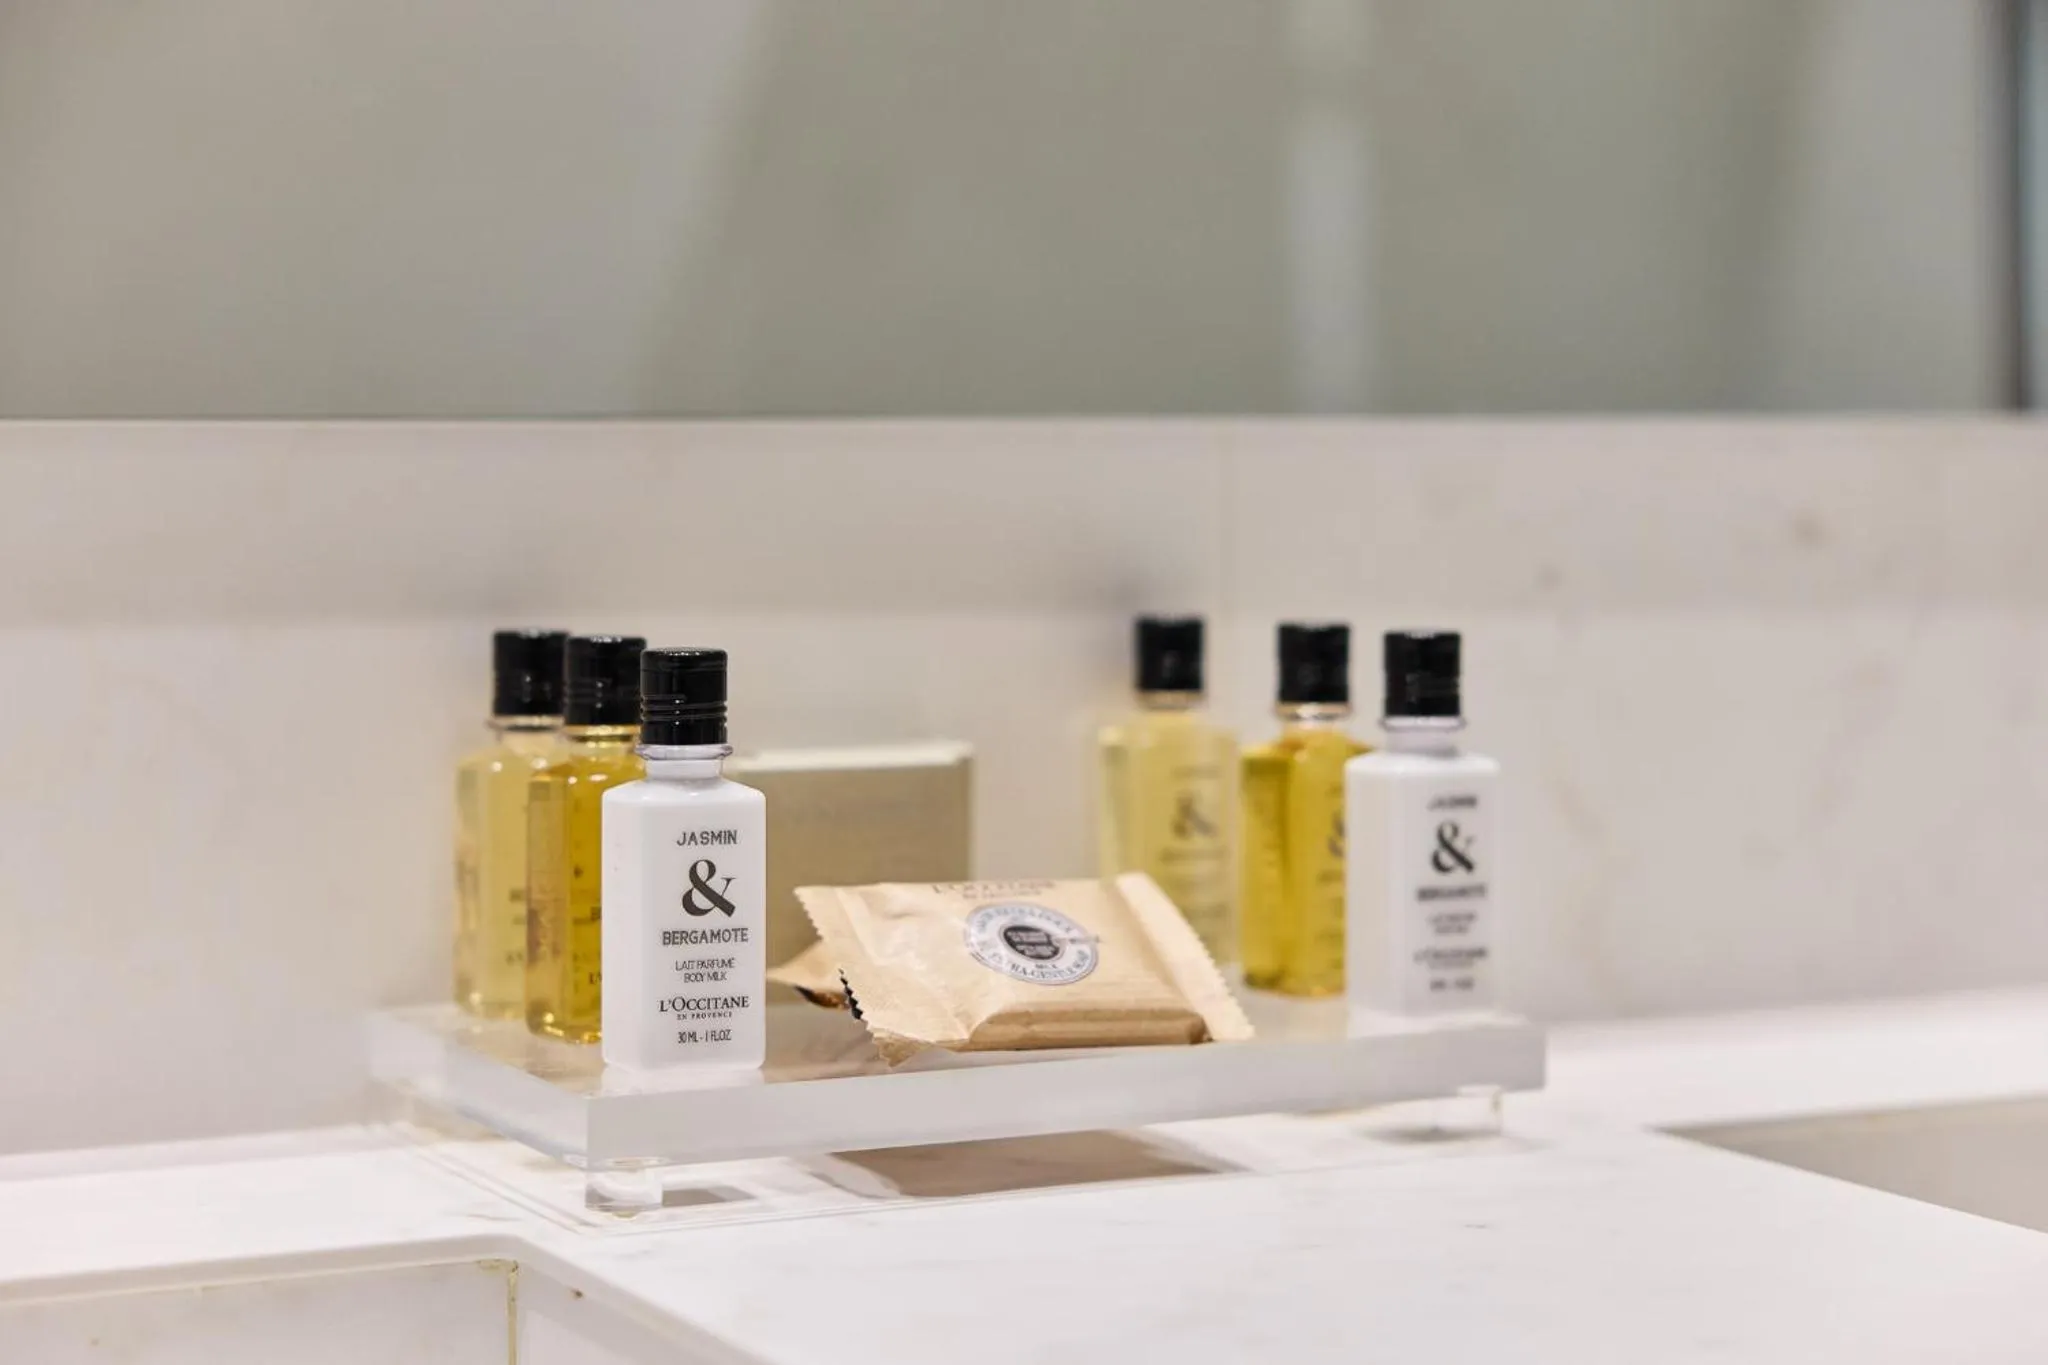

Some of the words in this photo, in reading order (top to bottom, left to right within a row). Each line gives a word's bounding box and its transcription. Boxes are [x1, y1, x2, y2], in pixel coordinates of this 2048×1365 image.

[676, 830, 738, 846] JASMIN
[1431, 820, 1475, 875] &
[682, 859, 736, 917] &
[662, 927, 749, 946] BERGAMOTE
[675, 959, 695, 971] LAIT
[684, 972, 704, 983] BODY
[707, 971, 727, 981] MILK
[659, 996, 749, 1012] L'OCCITANE
[692, 1011, 732, 1019] PROVENCE
